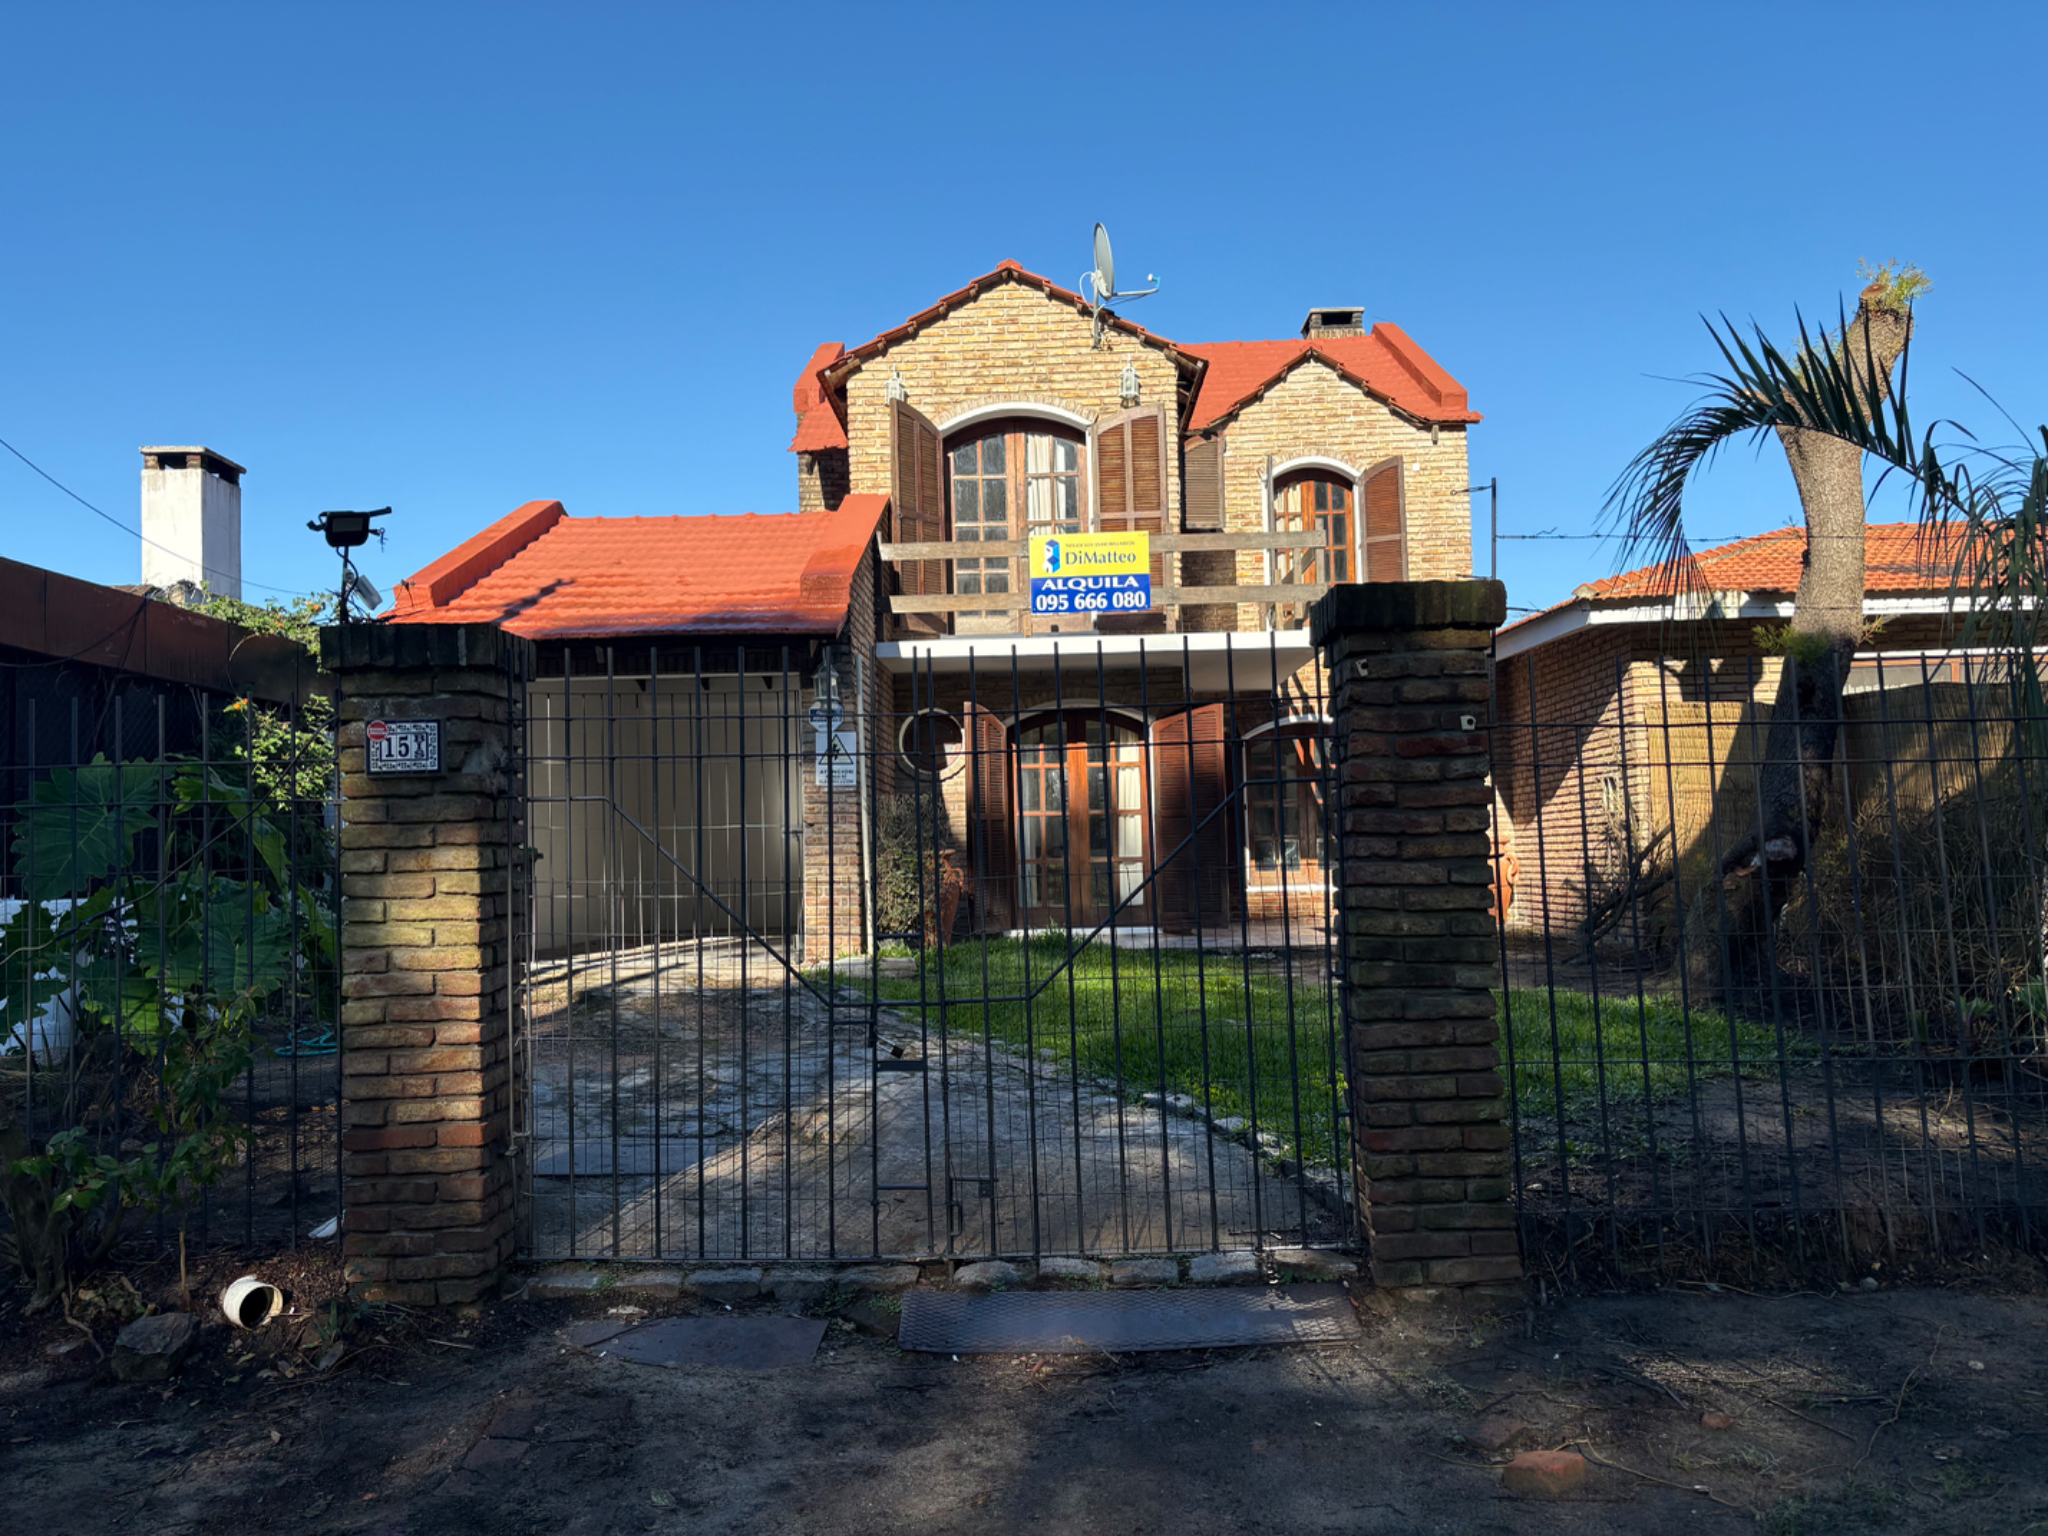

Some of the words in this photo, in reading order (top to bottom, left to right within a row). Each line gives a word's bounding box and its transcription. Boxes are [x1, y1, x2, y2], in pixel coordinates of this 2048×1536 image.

[1065, 551, 1136, 565] DiMatteo
[1041, 576, 1139, 592] ALQUILA
[1036, 594, 1069, 611] 095
[1074, 592, 1108, 610] 666
[1112, 591, 1146, 608] 080
[385, 735, 410, 758] 15
